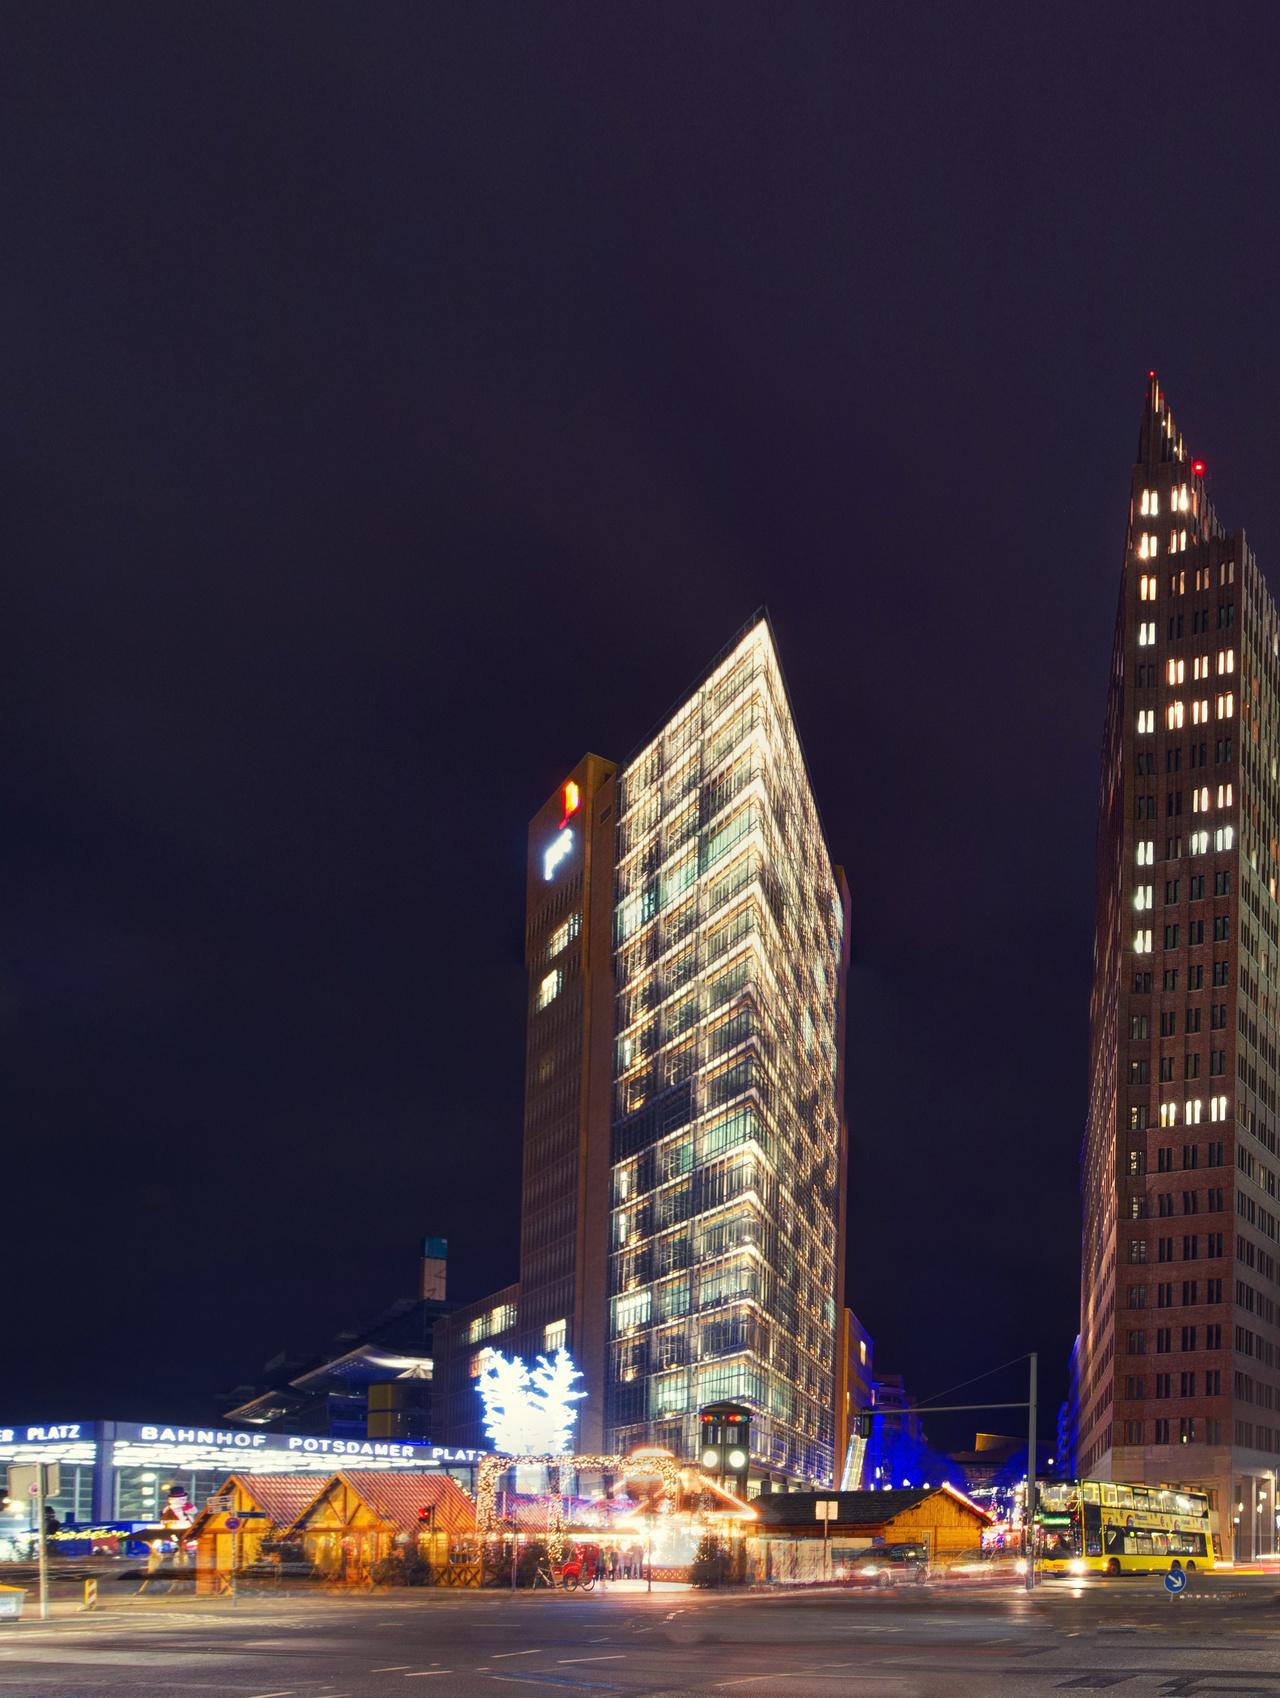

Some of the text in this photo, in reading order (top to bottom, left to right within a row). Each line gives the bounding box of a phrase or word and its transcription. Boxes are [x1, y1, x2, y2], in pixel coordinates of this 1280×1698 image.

[27, 1424, 81, 1441] PLATZ
[140, 1425, 488, 1462] BAHNHOF POTSDAMER PLATZ
